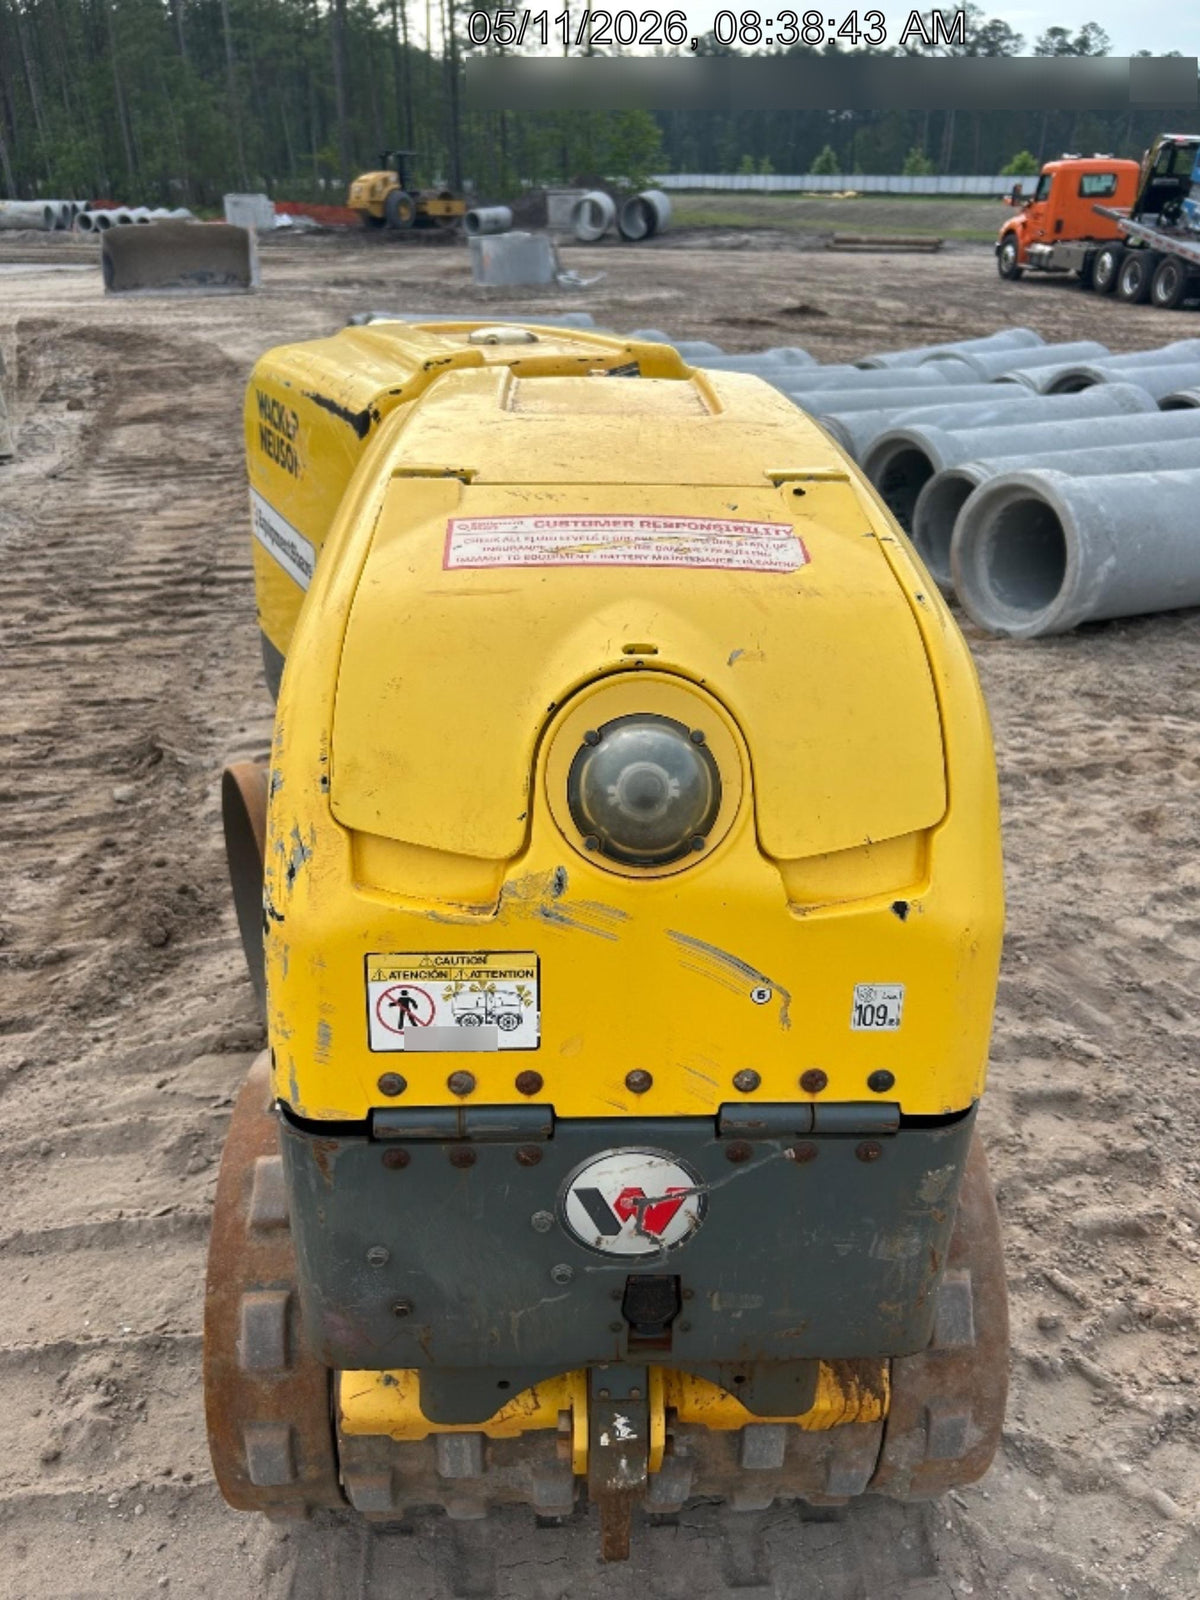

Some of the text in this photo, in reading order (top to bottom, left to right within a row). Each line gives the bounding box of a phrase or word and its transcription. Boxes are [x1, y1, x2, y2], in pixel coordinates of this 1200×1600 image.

[533, 519, 794, 536] CUSTOMER RESPONSIBILITY
[434, 956, 487, 965] CAUTION
[388, 969, 448, 980] ATENCIÓN
[470, 969, 534, 979] ATTENTION
[855, 1003, 888, 1026] 109
